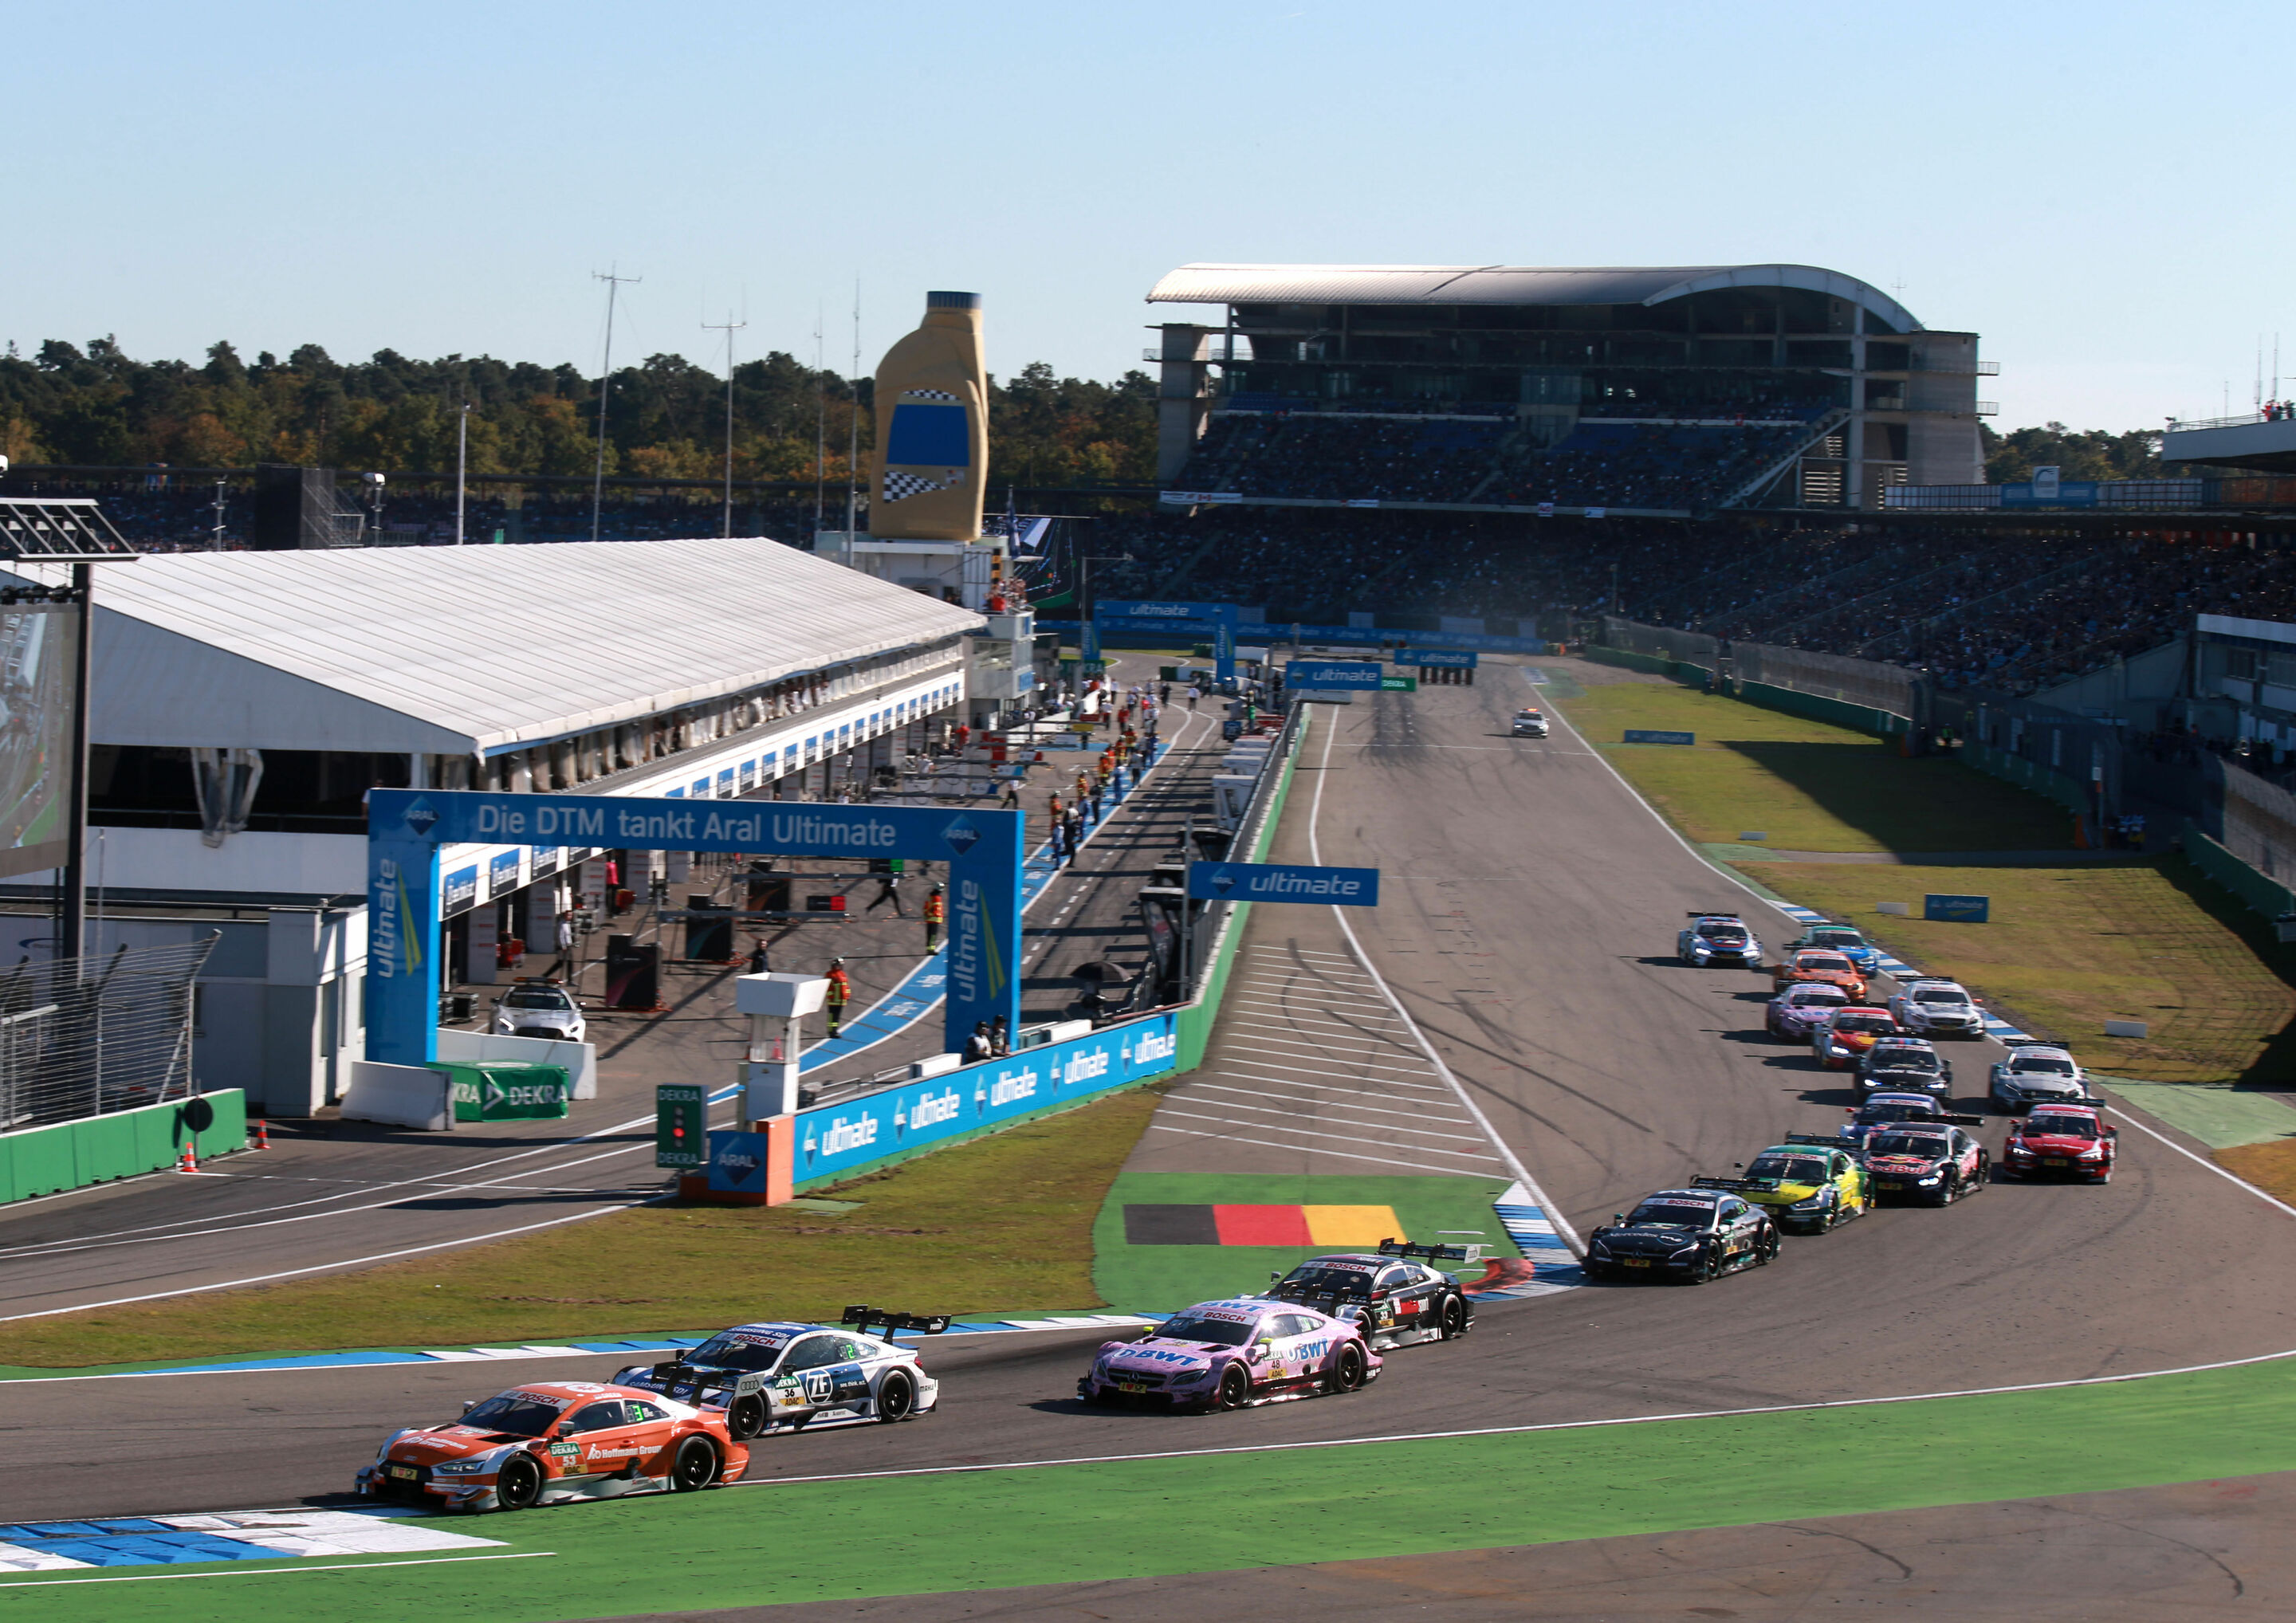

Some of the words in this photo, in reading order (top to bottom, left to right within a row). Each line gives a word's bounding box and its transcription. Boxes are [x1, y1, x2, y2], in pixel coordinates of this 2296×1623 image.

[1130, 603, 1189, 615] ultimate
[1419, 654, 1468, 663] ultimate
[1312, 668, 1378, 682] ultimate
[478, 804, 525, 834] Die
[537, 807, 604, 835] DTM
[619, 810, 695, 839] tankt
[702, 812, 761, 842] Aral
[773, 814, 896, 847] Ultimate
[1249, 872, 1360, 895] ultimate
[372, 859, 396, 978] ultimate
[957, 879, 980, 1003] ultimate
[1134, 1032, 1176, 1064] ultimate
[1064, 1045, 1109, 1084] ultimate
[991, 1066, 1037, 1106] ultimate
[452, 1083, 482, 1103] KRA
[509, 1085, 568, 1106] DEKRA
[659, 1089, 699, 1102] DEKRA
[910, 1087, 961, 1130] ultimate
[822, 1111, 878, 1156] ultimate
[659, 1152, 698, 1164] DEKRA
[718, 1153, 756, 1166] ARAL
[1325, 1263, 1366, 1271] BOSCH
[1201, 1302, 1267, 1312] BWT
[1204, 1311, 1246, 1322] BOSCH
[1380, 1311, 1388, 1320] 33
[730, 1326, 772, 1337] SAMSUNG
[773, 1330, 790, 1339] SDI
[733, 1334, 776, 1346] BOSCH
[1299, 1338, 1329, 1360] BWT
[1135, 1350, 1199, 1366] BWT
[1271, 1360, 1280, 1369] 48
[630, 1381, 666, 1390] SAMSUN
[517, 1392, 561, 1405] BOSCH
[784, 1388, 795, 1397] 36
[631, 1405, 644, 1421] 3
[551, 1444, 579, 1456] DEKRA
[602, 1448, 638, 1459] Hoffmann
[639, 1445, 662, 1455] Group
[562, 1455, 577, 1467] 53
[563, 1465, 581, 1474] ADAC
